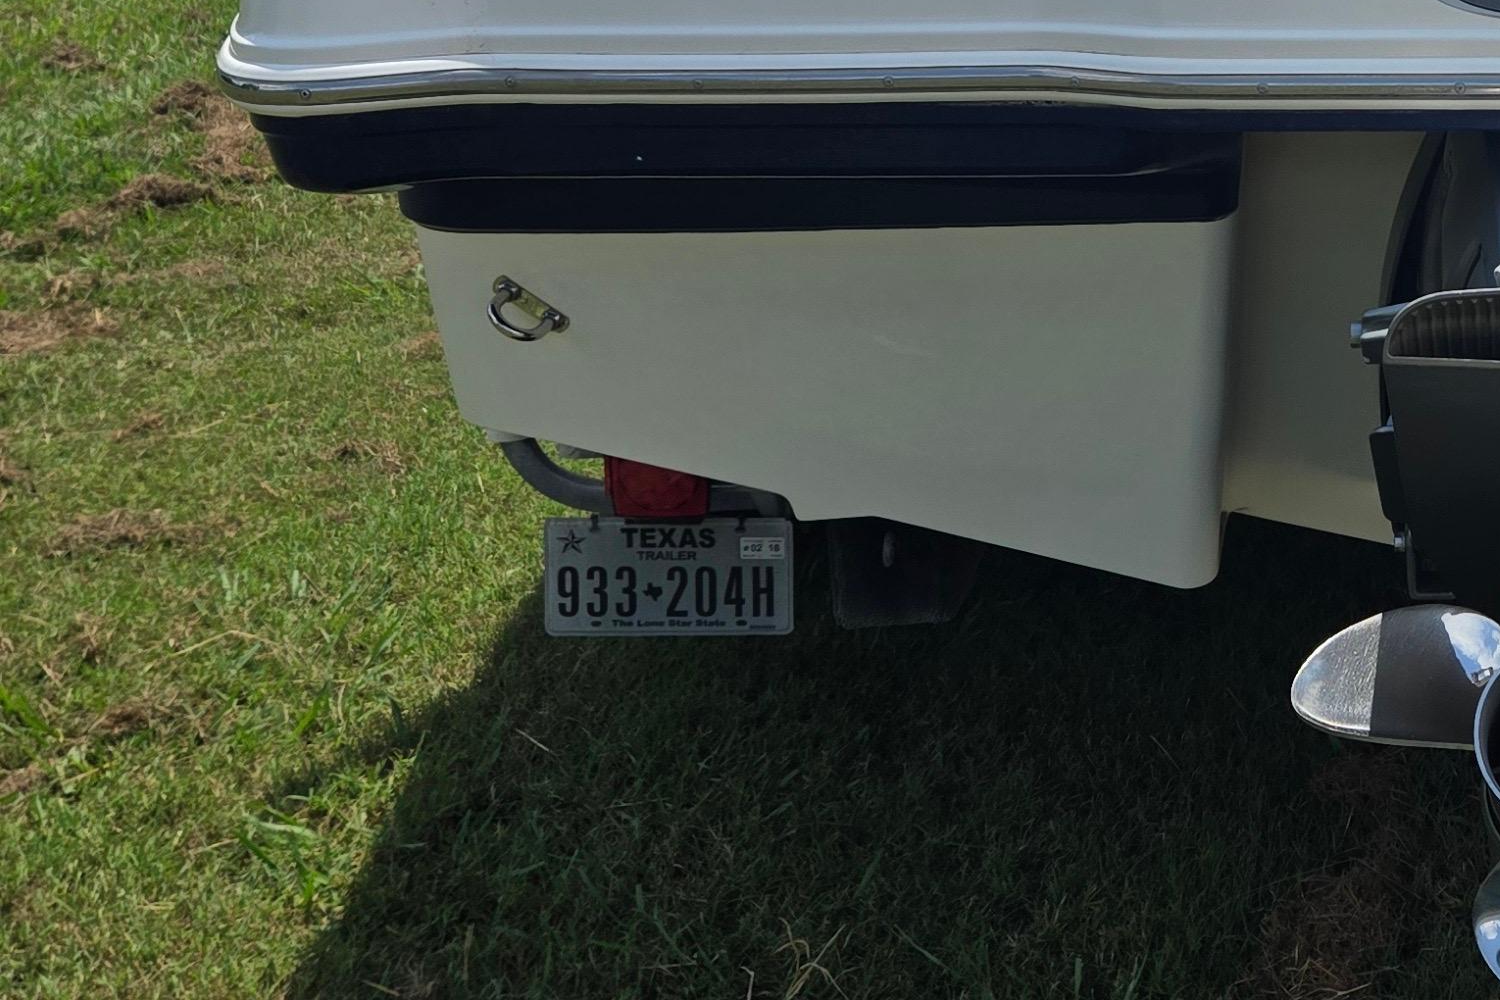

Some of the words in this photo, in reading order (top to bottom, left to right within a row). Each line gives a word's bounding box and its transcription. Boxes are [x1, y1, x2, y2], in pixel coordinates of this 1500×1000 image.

[620, 528, 716, 549] TEXAS
[636, 551, 697, 561] TRAILER
[557, 566, 638, 618] 933
[665, 566, 775, 618] 204H
[612, 619, 633, 627] The
[637, 619, 665, 627] Lone
[668, 619, 693, 627] Star
[695, 619, 726, 628] State
